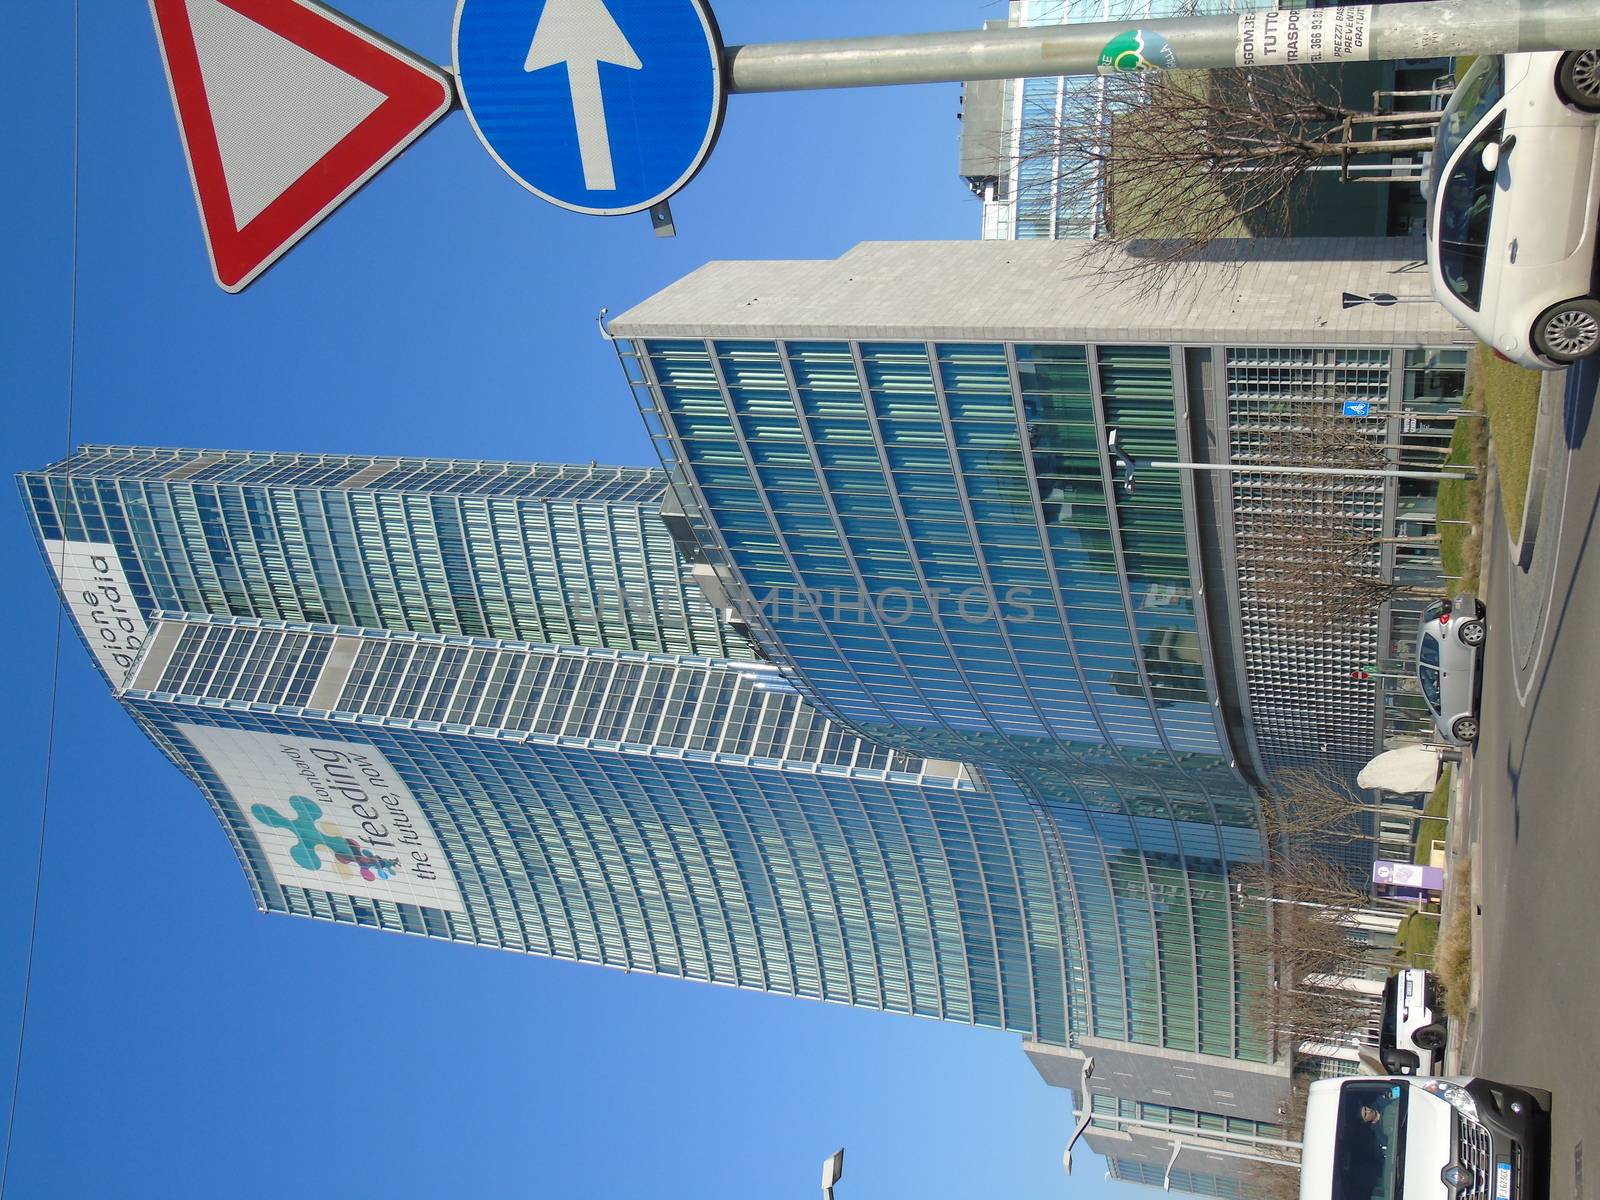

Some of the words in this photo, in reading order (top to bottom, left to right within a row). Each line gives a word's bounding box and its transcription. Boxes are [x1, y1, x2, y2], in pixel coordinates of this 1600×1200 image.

[1264, 12, 1278, 56] TUTTO
[1310, 32, 1322, 49] 366
[1334, 24, 1342, 57] PREZZI
[82, 590, 134, 676] gione
[280, 744, 333, 802] Lombardy
[349, 752, 390, 787] now
[309, 748, 396, 847] feeding
[380, 792, 422, 845] future,
[411, 851, 437, 880] the
